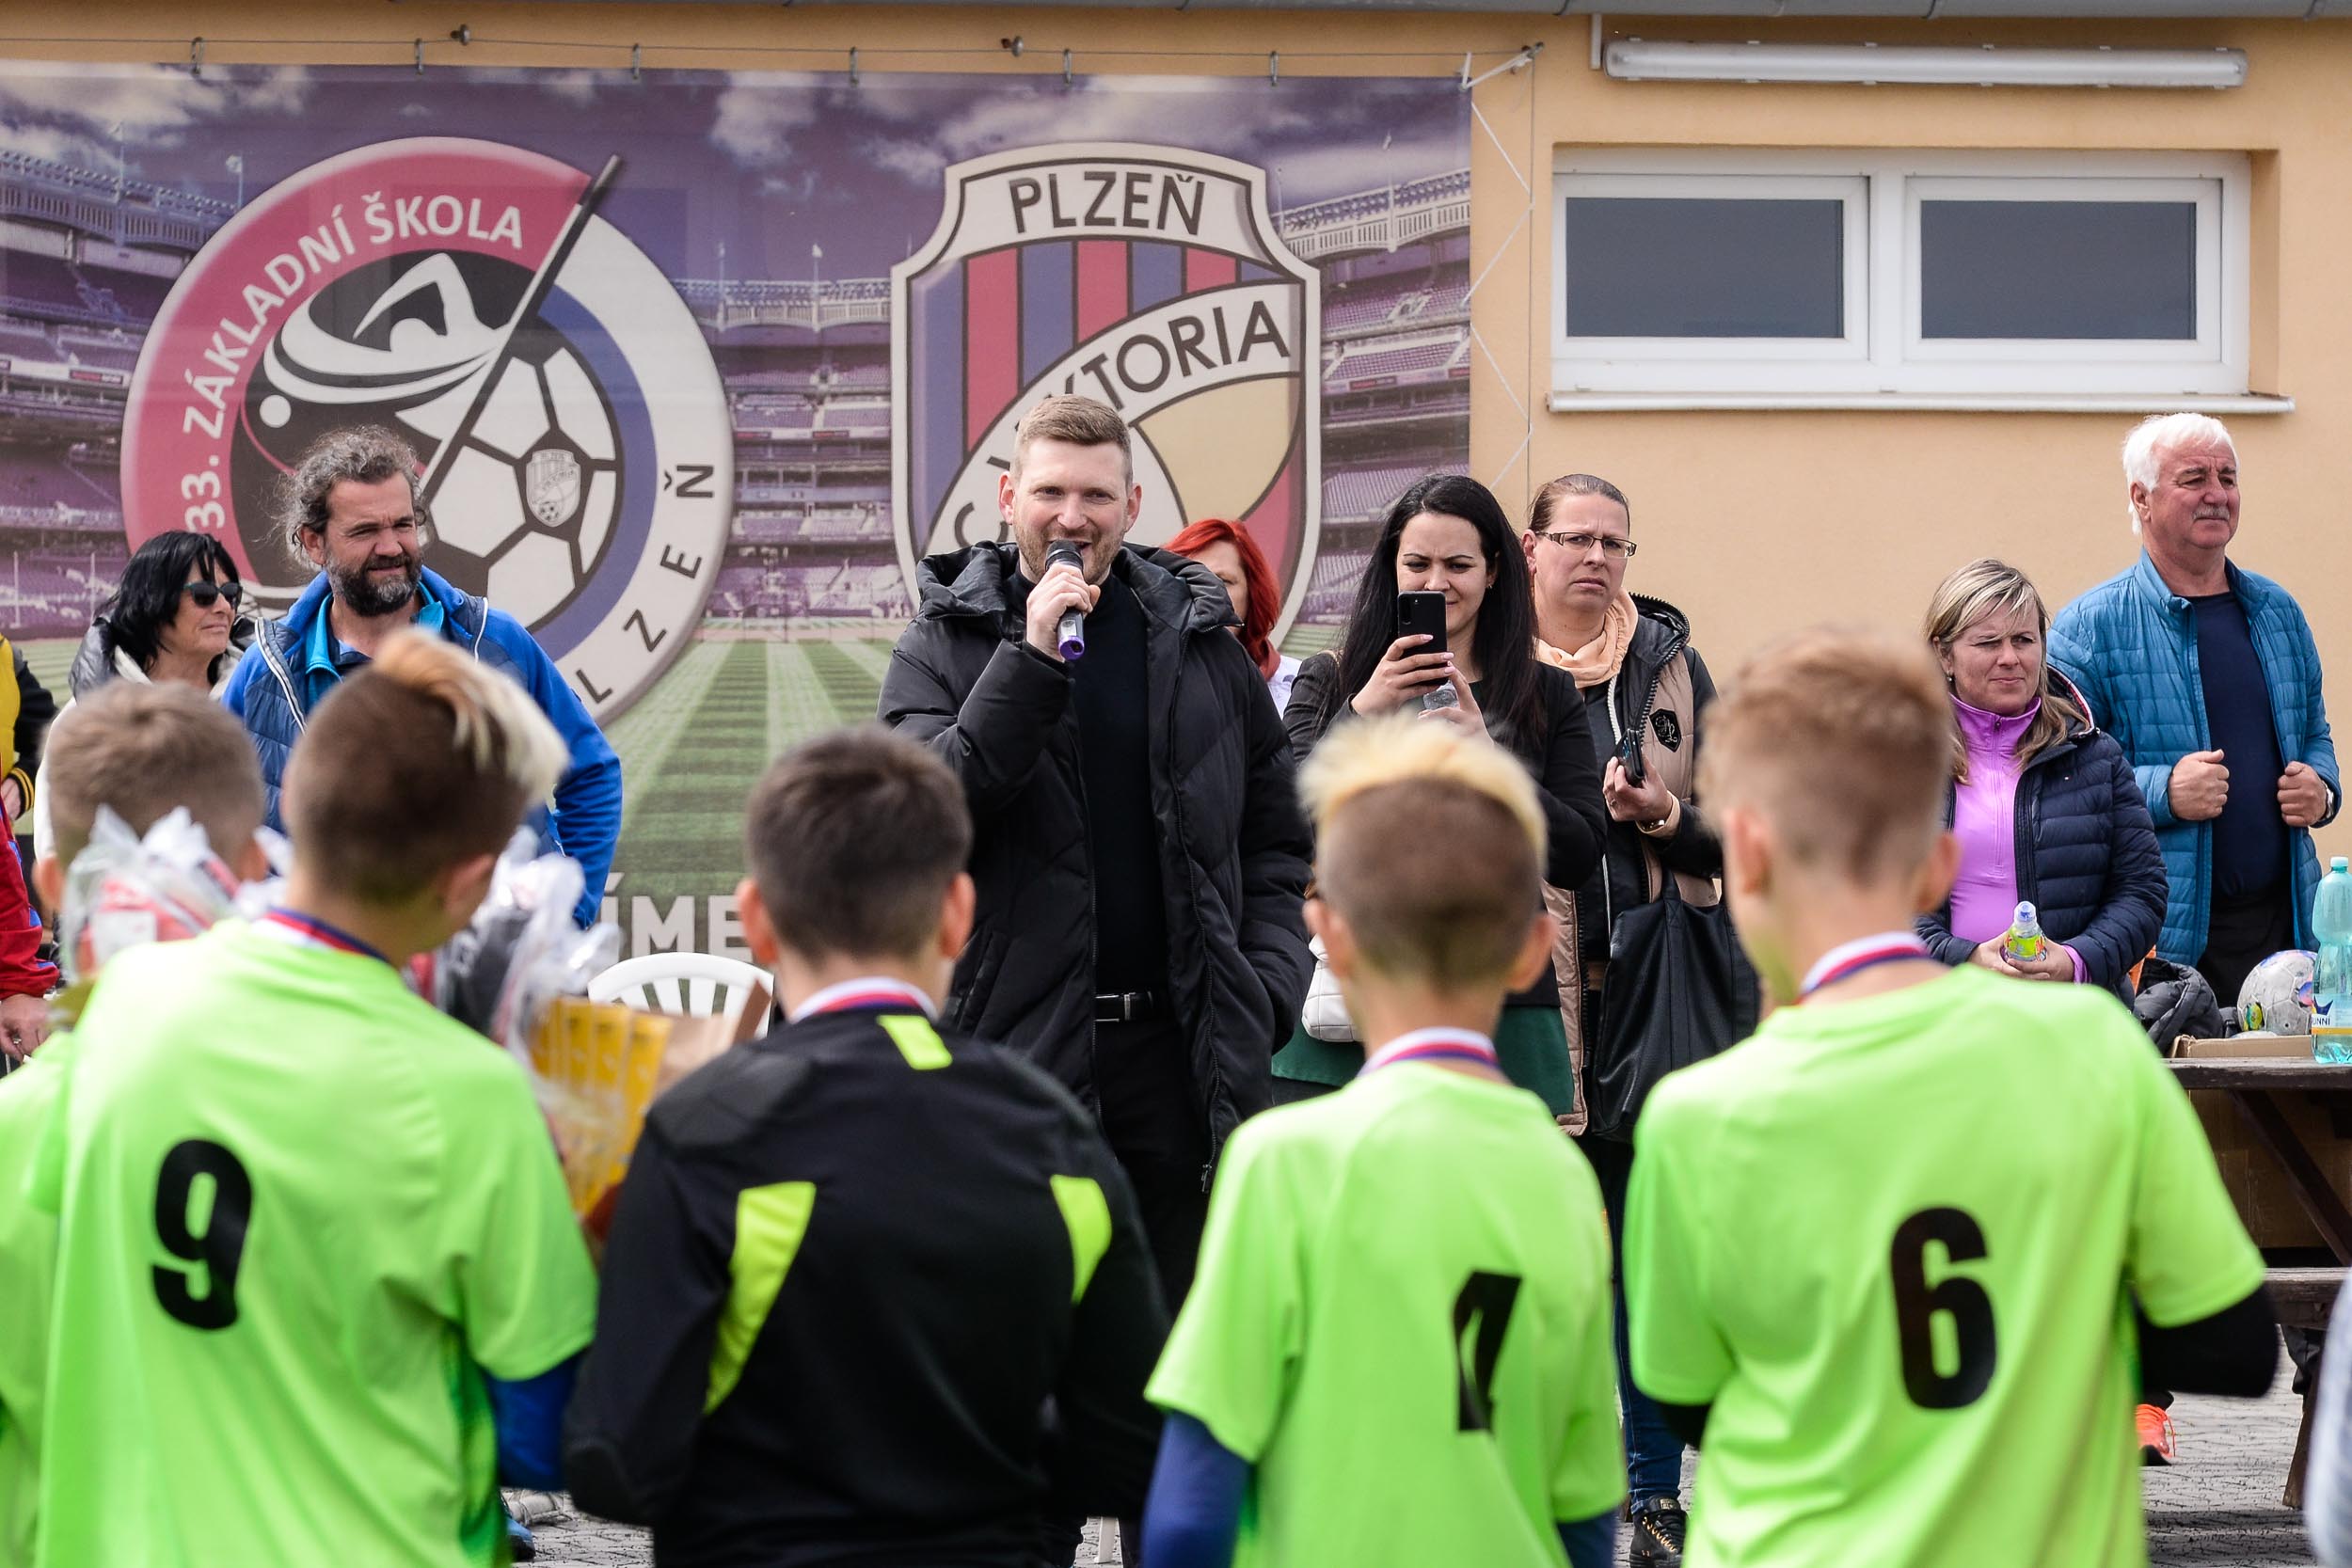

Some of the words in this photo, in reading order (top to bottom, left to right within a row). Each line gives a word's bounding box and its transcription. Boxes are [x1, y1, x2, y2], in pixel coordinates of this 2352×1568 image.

[363, 191, 524, 249] ŠKOLA
[1009, 171, 1206, 235] PLZEŇ
[183, 203, 358, 439] ZÁKLADNÍ
[180, 454, 227, 531] 33.
[151, 1138, 253, 1330] 9
[1891, 1207, 1996, 1410] 6
